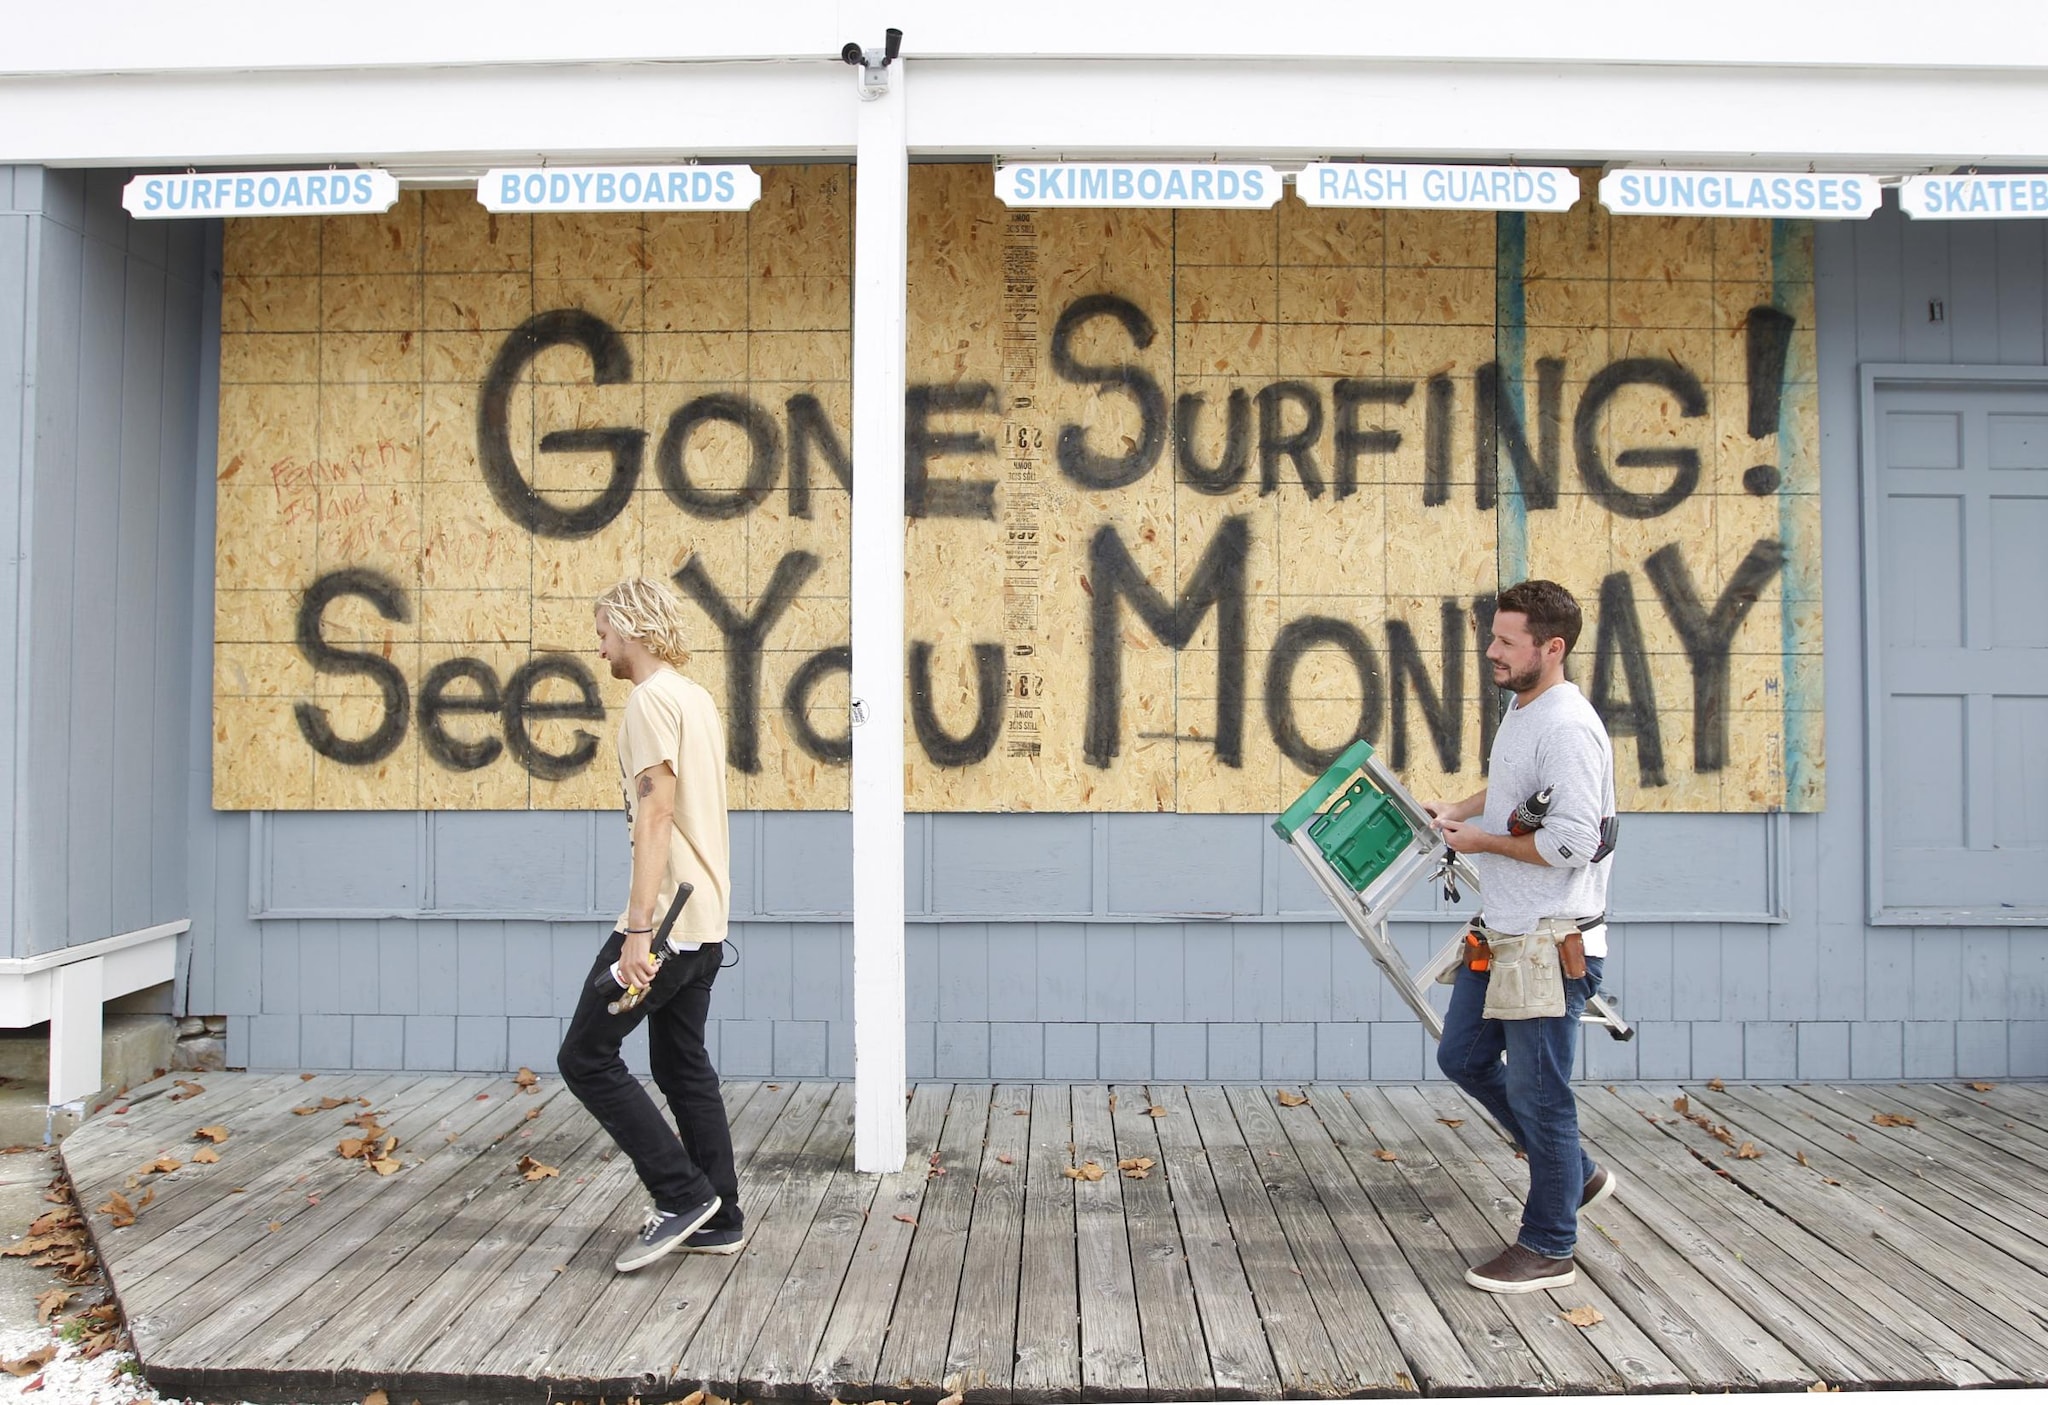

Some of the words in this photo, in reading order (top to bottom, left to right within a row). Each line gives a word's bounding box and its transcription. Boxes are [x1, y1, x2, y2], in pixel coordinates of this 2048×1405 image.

[143, 172, 373, 212] SURFBOARDS
[501, 170, 735, 205] BODYBOARDS
[1014, 166, 1264, 202] SKIMBOARDS
[1318, 167, 1407, 201] RASH
[1422, 168, 1556, 204] GUARDS
[1620, 174, 1863, 211] SUNGLASSES
[1924, 179, 2048, 212] SKATEB
[1007, 532, 1036, 540] APA
